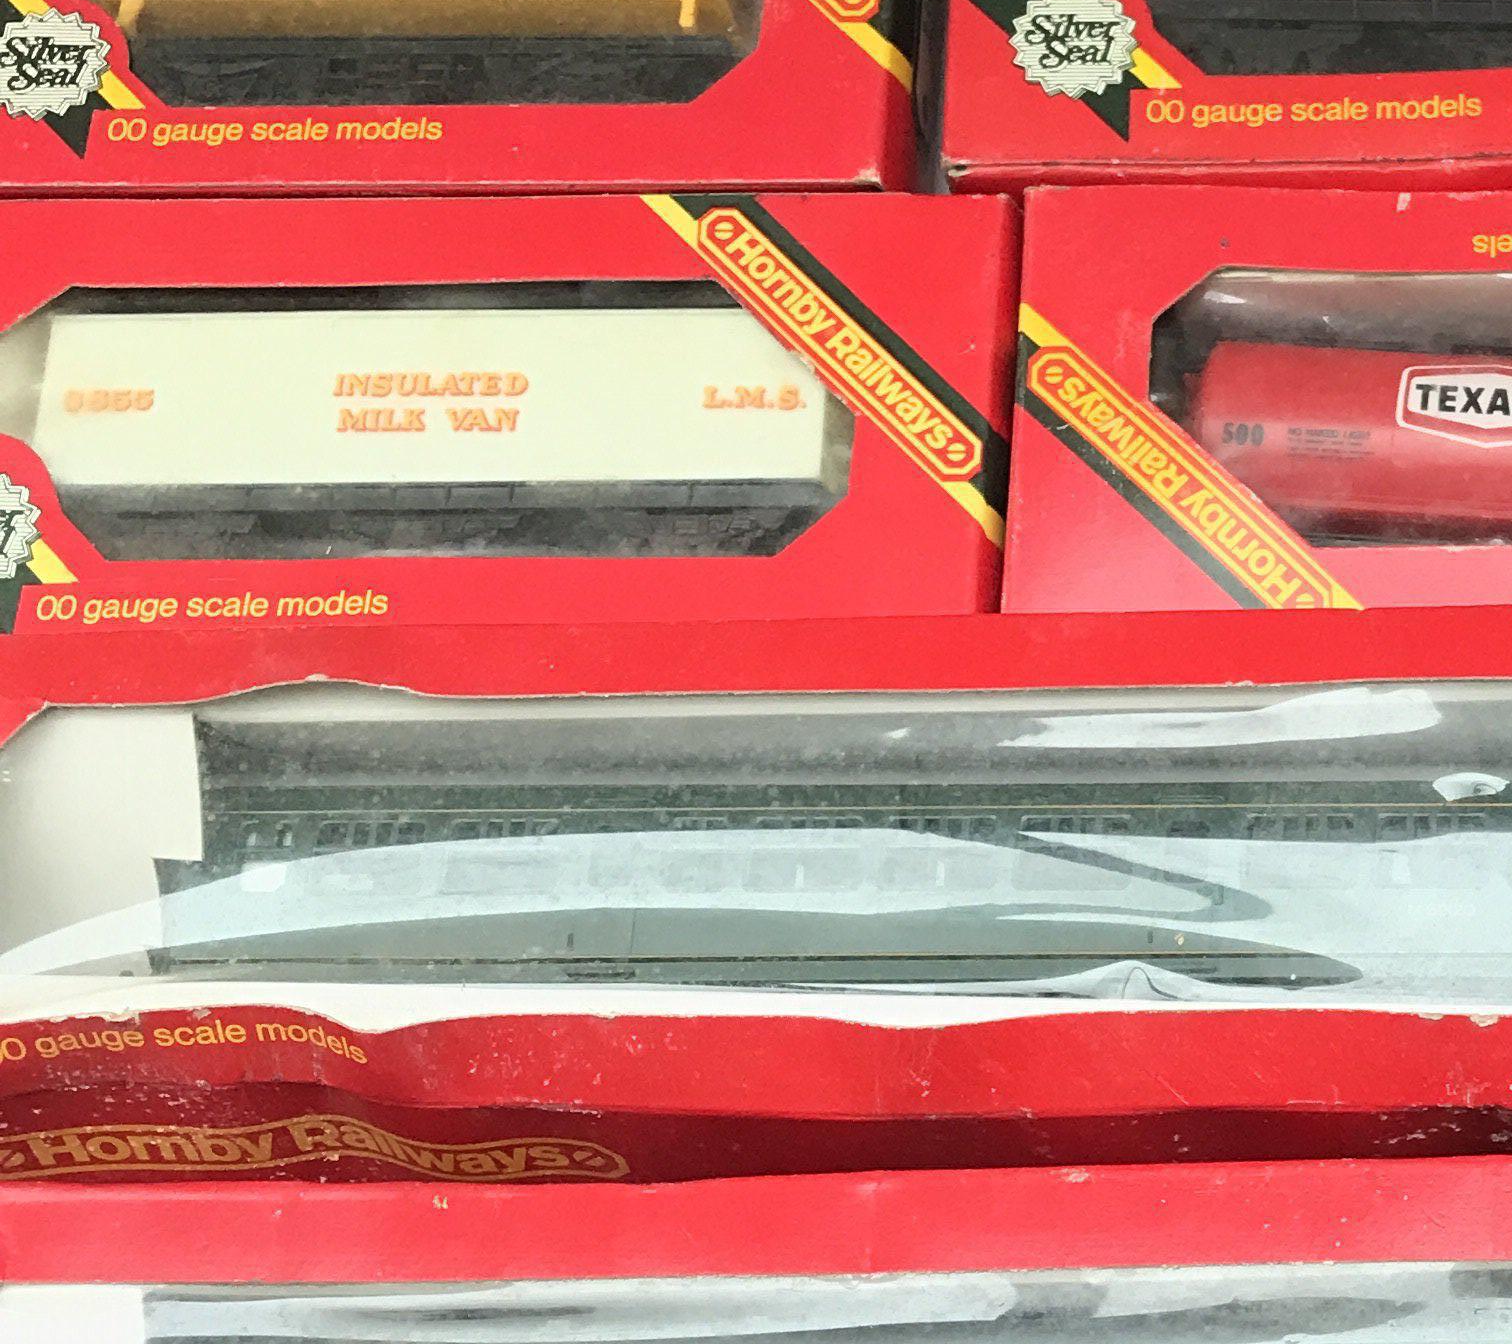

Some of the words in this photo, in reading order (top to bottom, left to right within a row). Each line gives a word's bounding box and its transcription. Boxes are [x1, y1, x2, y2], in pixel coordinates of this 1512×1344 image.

[1024, 13, 1121, 46] Silver
[1, 36, 100, 67] Silver
[1038, 35, 1114, 69] Seal
[7, 58, 82, 92] Seal
[1191, 99, 1284, 129] gauge
[1290, 96, 1369, 123] scale
[1375, 93, 1483, 121] models
[152, 119, 243, 147] gauge
[250, 118, 328, 142] scale
[335, 116, 443, 143] models
[724, 232, 838, 336] Hornby
[825, 328, 954, 450] Railways
[332, 373, 529, 397] INSULATED
[702, 384, 808, 411] L.M.S.
[336, 407, 427, 433] MILK
[445, 407, 521, 433] VAN
[1057, 376, 1188, 498] Railways
[1180, 490, 1302, 605] Hornby
[83, 594, 178, 624] gauge
[186, 591, 269, 618] scale
[276, 589, 389, 617] models
[34, 1024, 146, 1059] gauge
[153, 1019, 248, 1047] scale
[255, 1020, 370, 1065] models
[26, 1128, 275, 1167] Hornby
[292, 1118, 563, 1177] Railways
